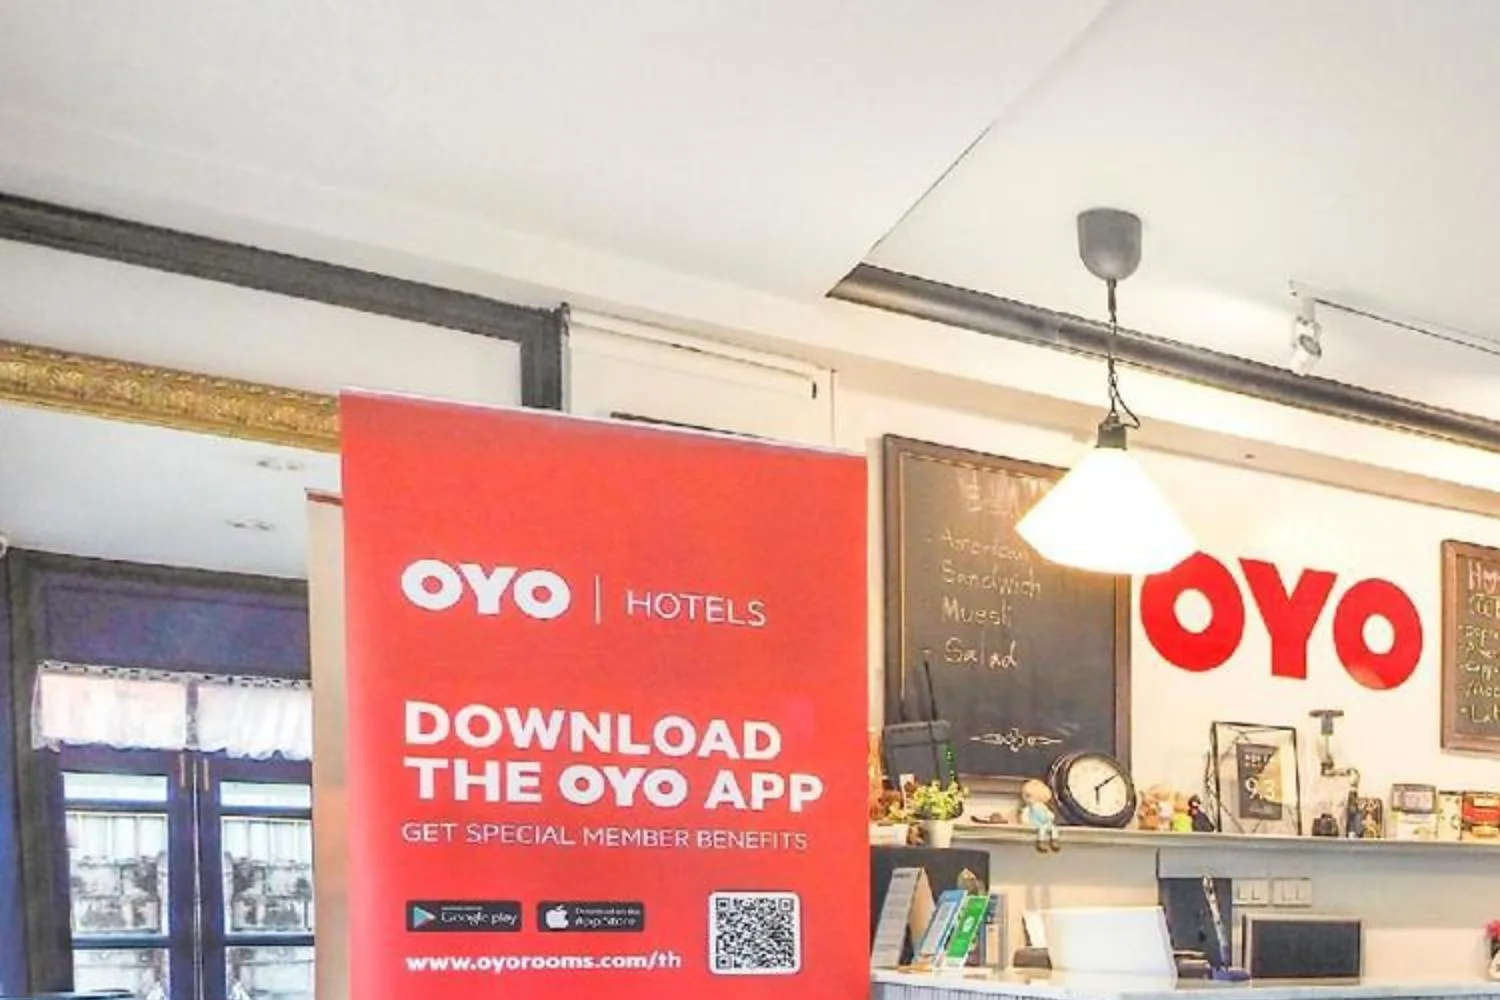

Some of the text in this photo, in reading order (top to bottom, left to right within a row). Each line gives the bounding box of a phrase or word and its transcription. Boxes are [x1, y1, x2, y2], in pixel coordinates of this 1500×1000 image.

[400, 559, 767, 628] OYO HOTELS
[1140, 551, 1423, 690] OYO
[944, 637, 1018, 669] Salad
[404, 700, 783, 761] DOWNLOAD
[404, 757, 825, 813] THE OYO APP
[402, 823, 808, 851] GET SPECIAL MEMBER BENEFITS
[491, 911, 518, 925] play
[575, 916, 637, 928] App Store
[406, 950, 682, 974] www.oyorooms.com/th
